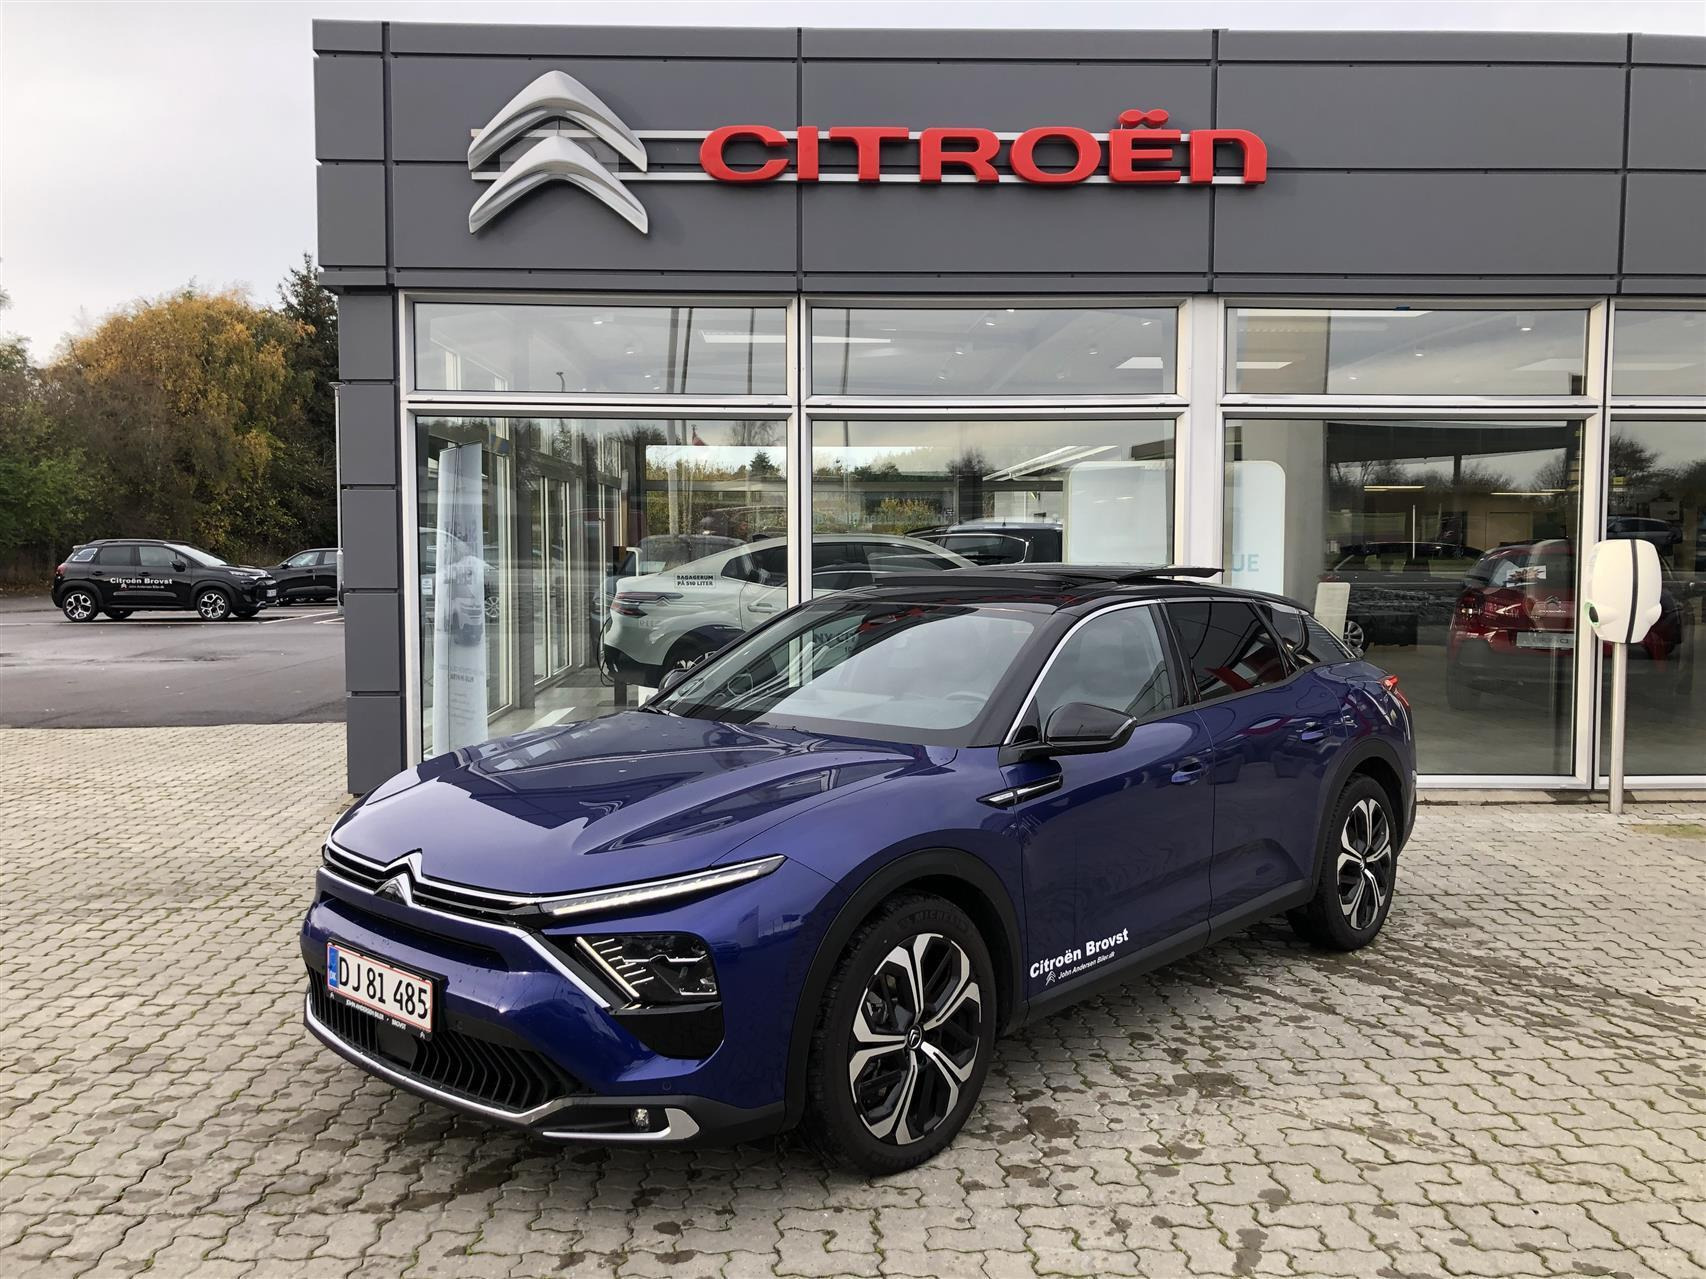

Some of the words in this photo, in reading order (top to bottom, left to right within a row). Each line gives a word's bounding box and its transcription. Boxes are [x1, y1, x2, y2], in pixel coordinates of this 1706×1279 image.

[699, 107, 1268, 185] CITROËN
[144, 577, 173, 585] Brovst
[1029, 949, 1082, 978] Citroën
[1085, 927, 1129, 957] Brovst
[1058, 968, 1072, 980] John
[1072, 959, 1097, 974] Andersen
[339, 956, 361, 992] DJ
[366, 967, 386, 1005] 81
[393, 979, 428, 1020] 485
